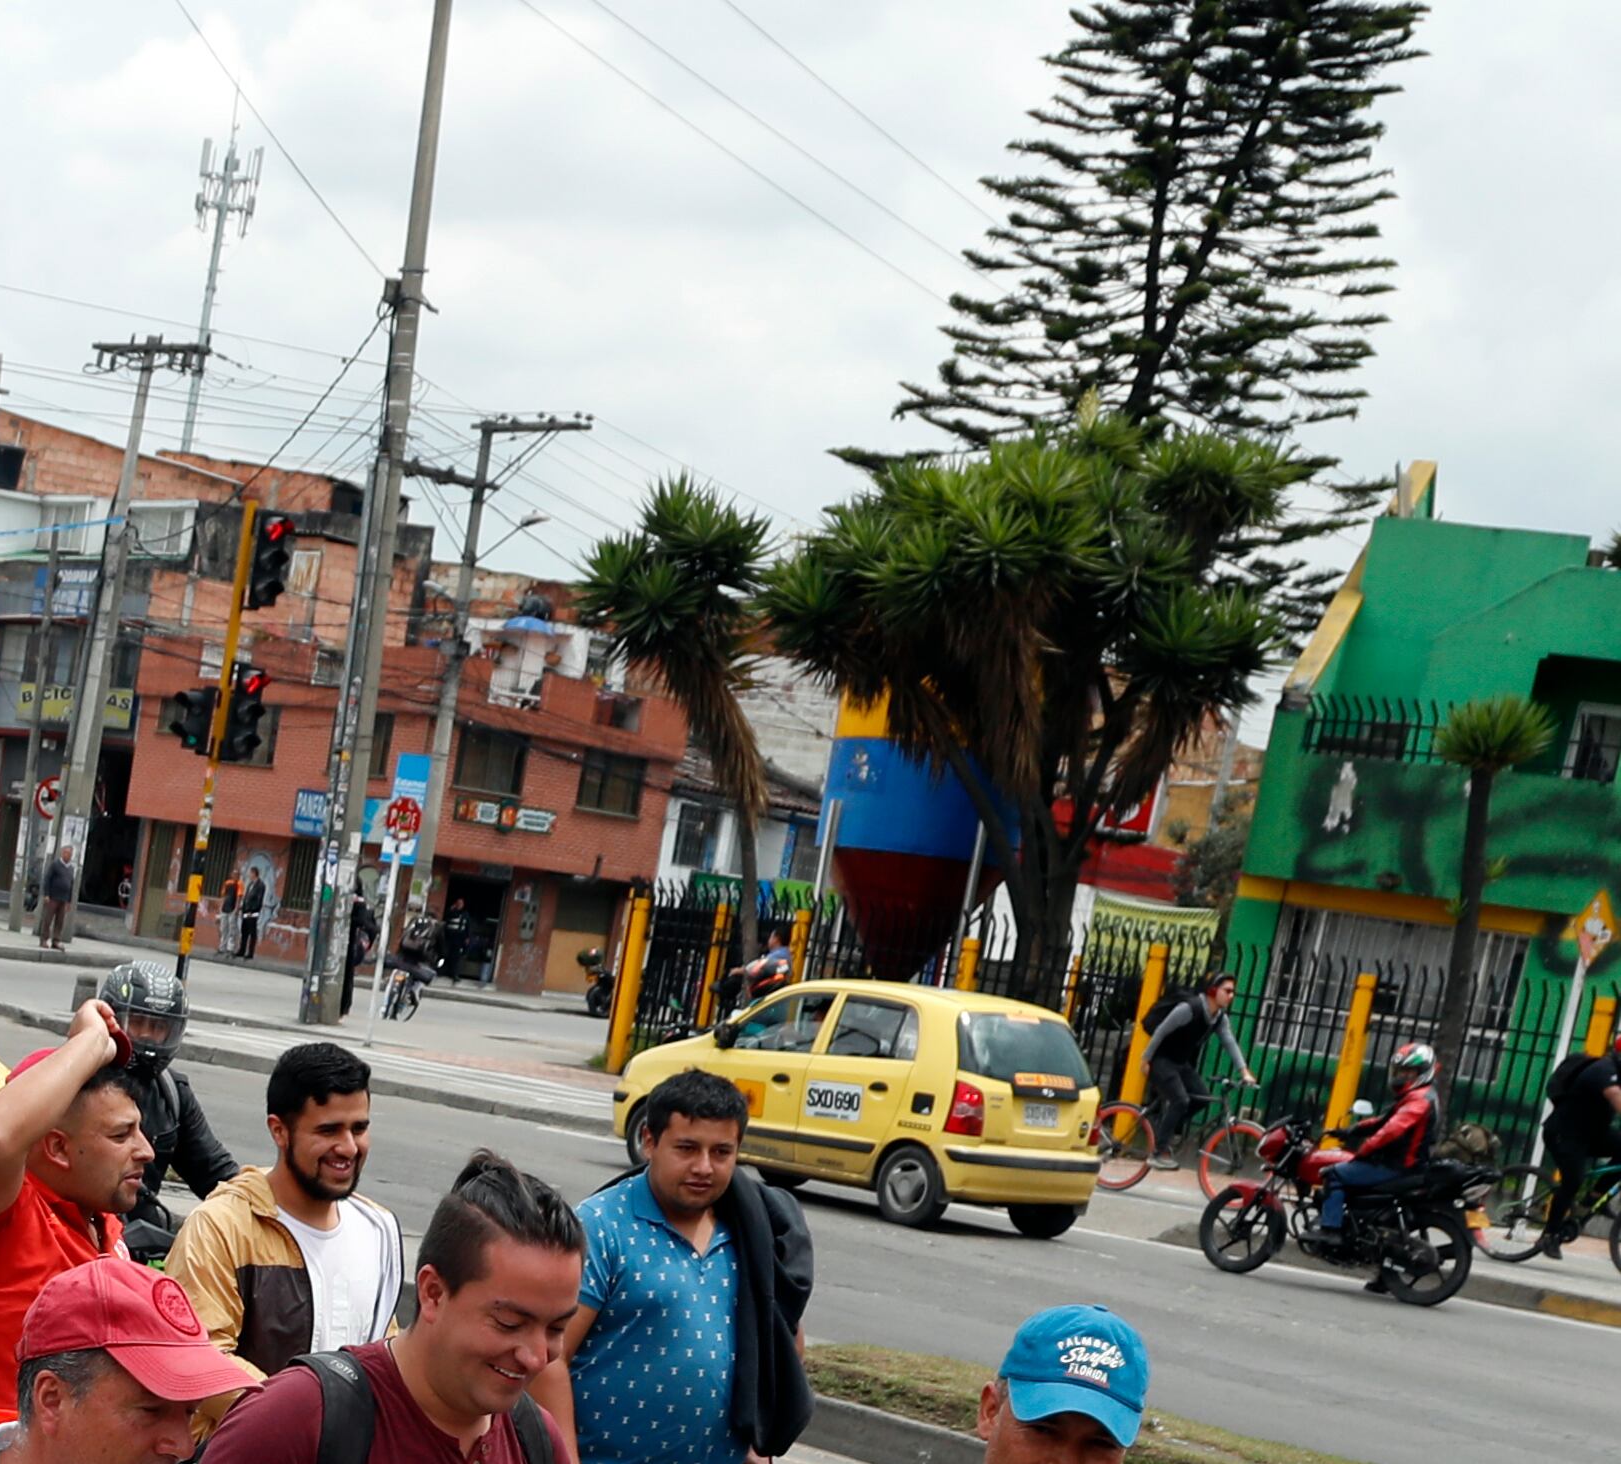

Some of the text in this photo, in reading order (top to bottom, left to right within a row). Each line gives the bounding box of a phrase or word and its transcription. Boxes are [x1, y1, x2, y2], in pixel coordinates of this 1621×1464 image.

[21, 686, 131, 711] BCICAS
[389, 808, 418, 828] PRE
[1068, 1362, 1109, 1383] FLORIDA
